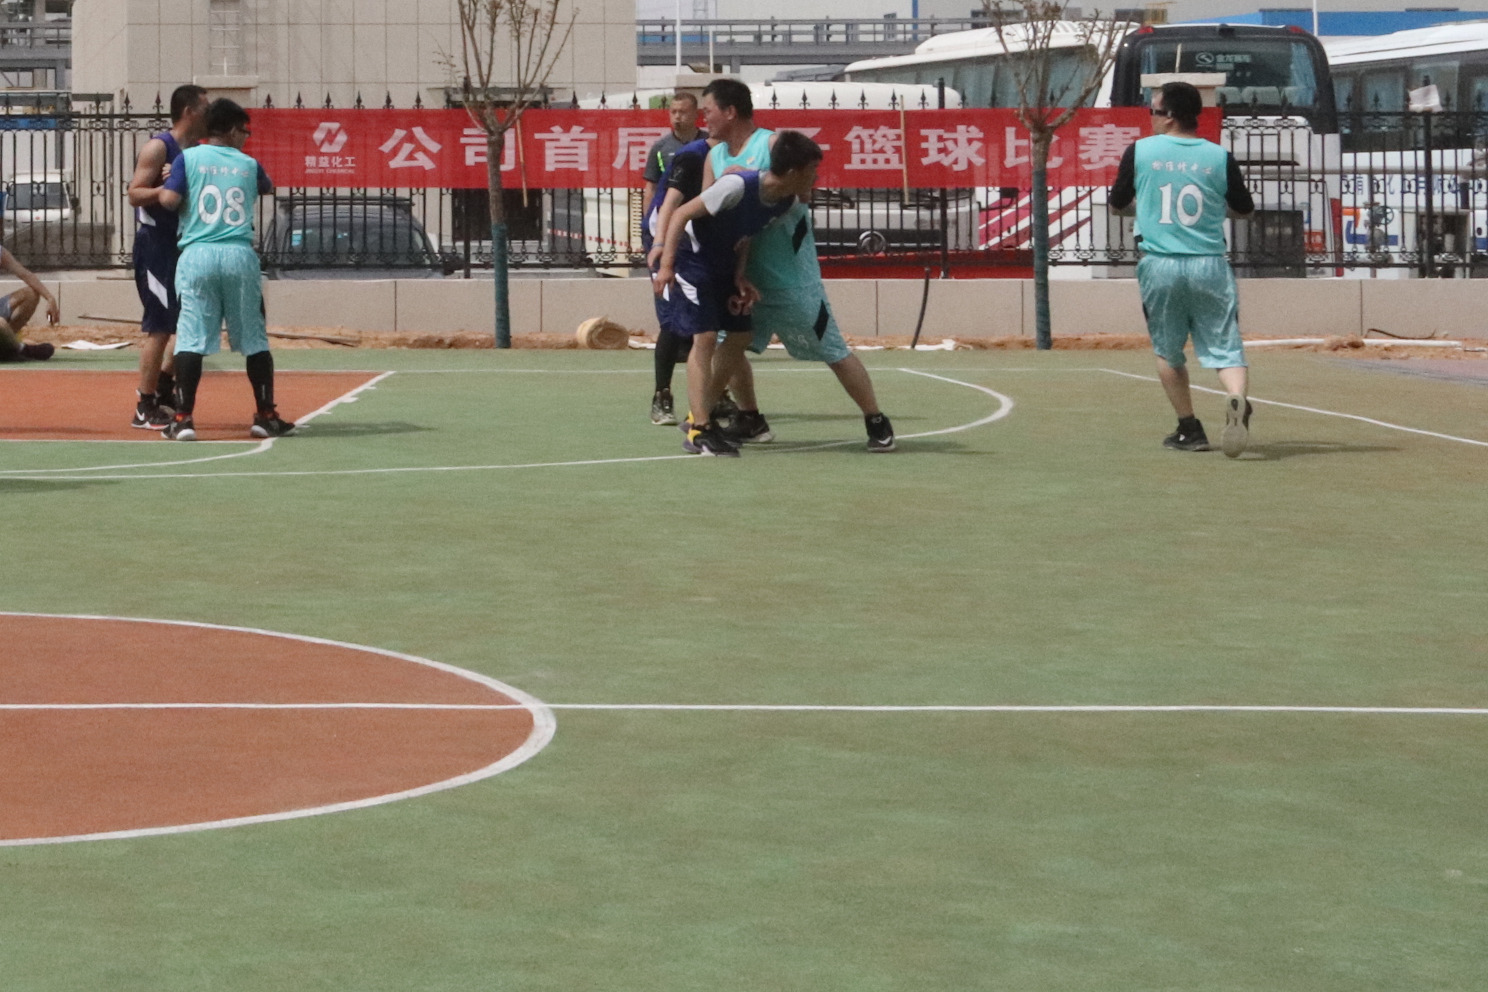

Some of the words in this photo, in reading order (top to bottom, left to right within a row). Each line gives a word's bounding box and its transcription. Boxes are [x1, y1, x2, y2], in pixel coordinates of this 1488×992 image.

[305, 155, 355, 167] 精益化工
[198, 184, 245, 226] 08
[1158, 182, 1203, 226] 10
